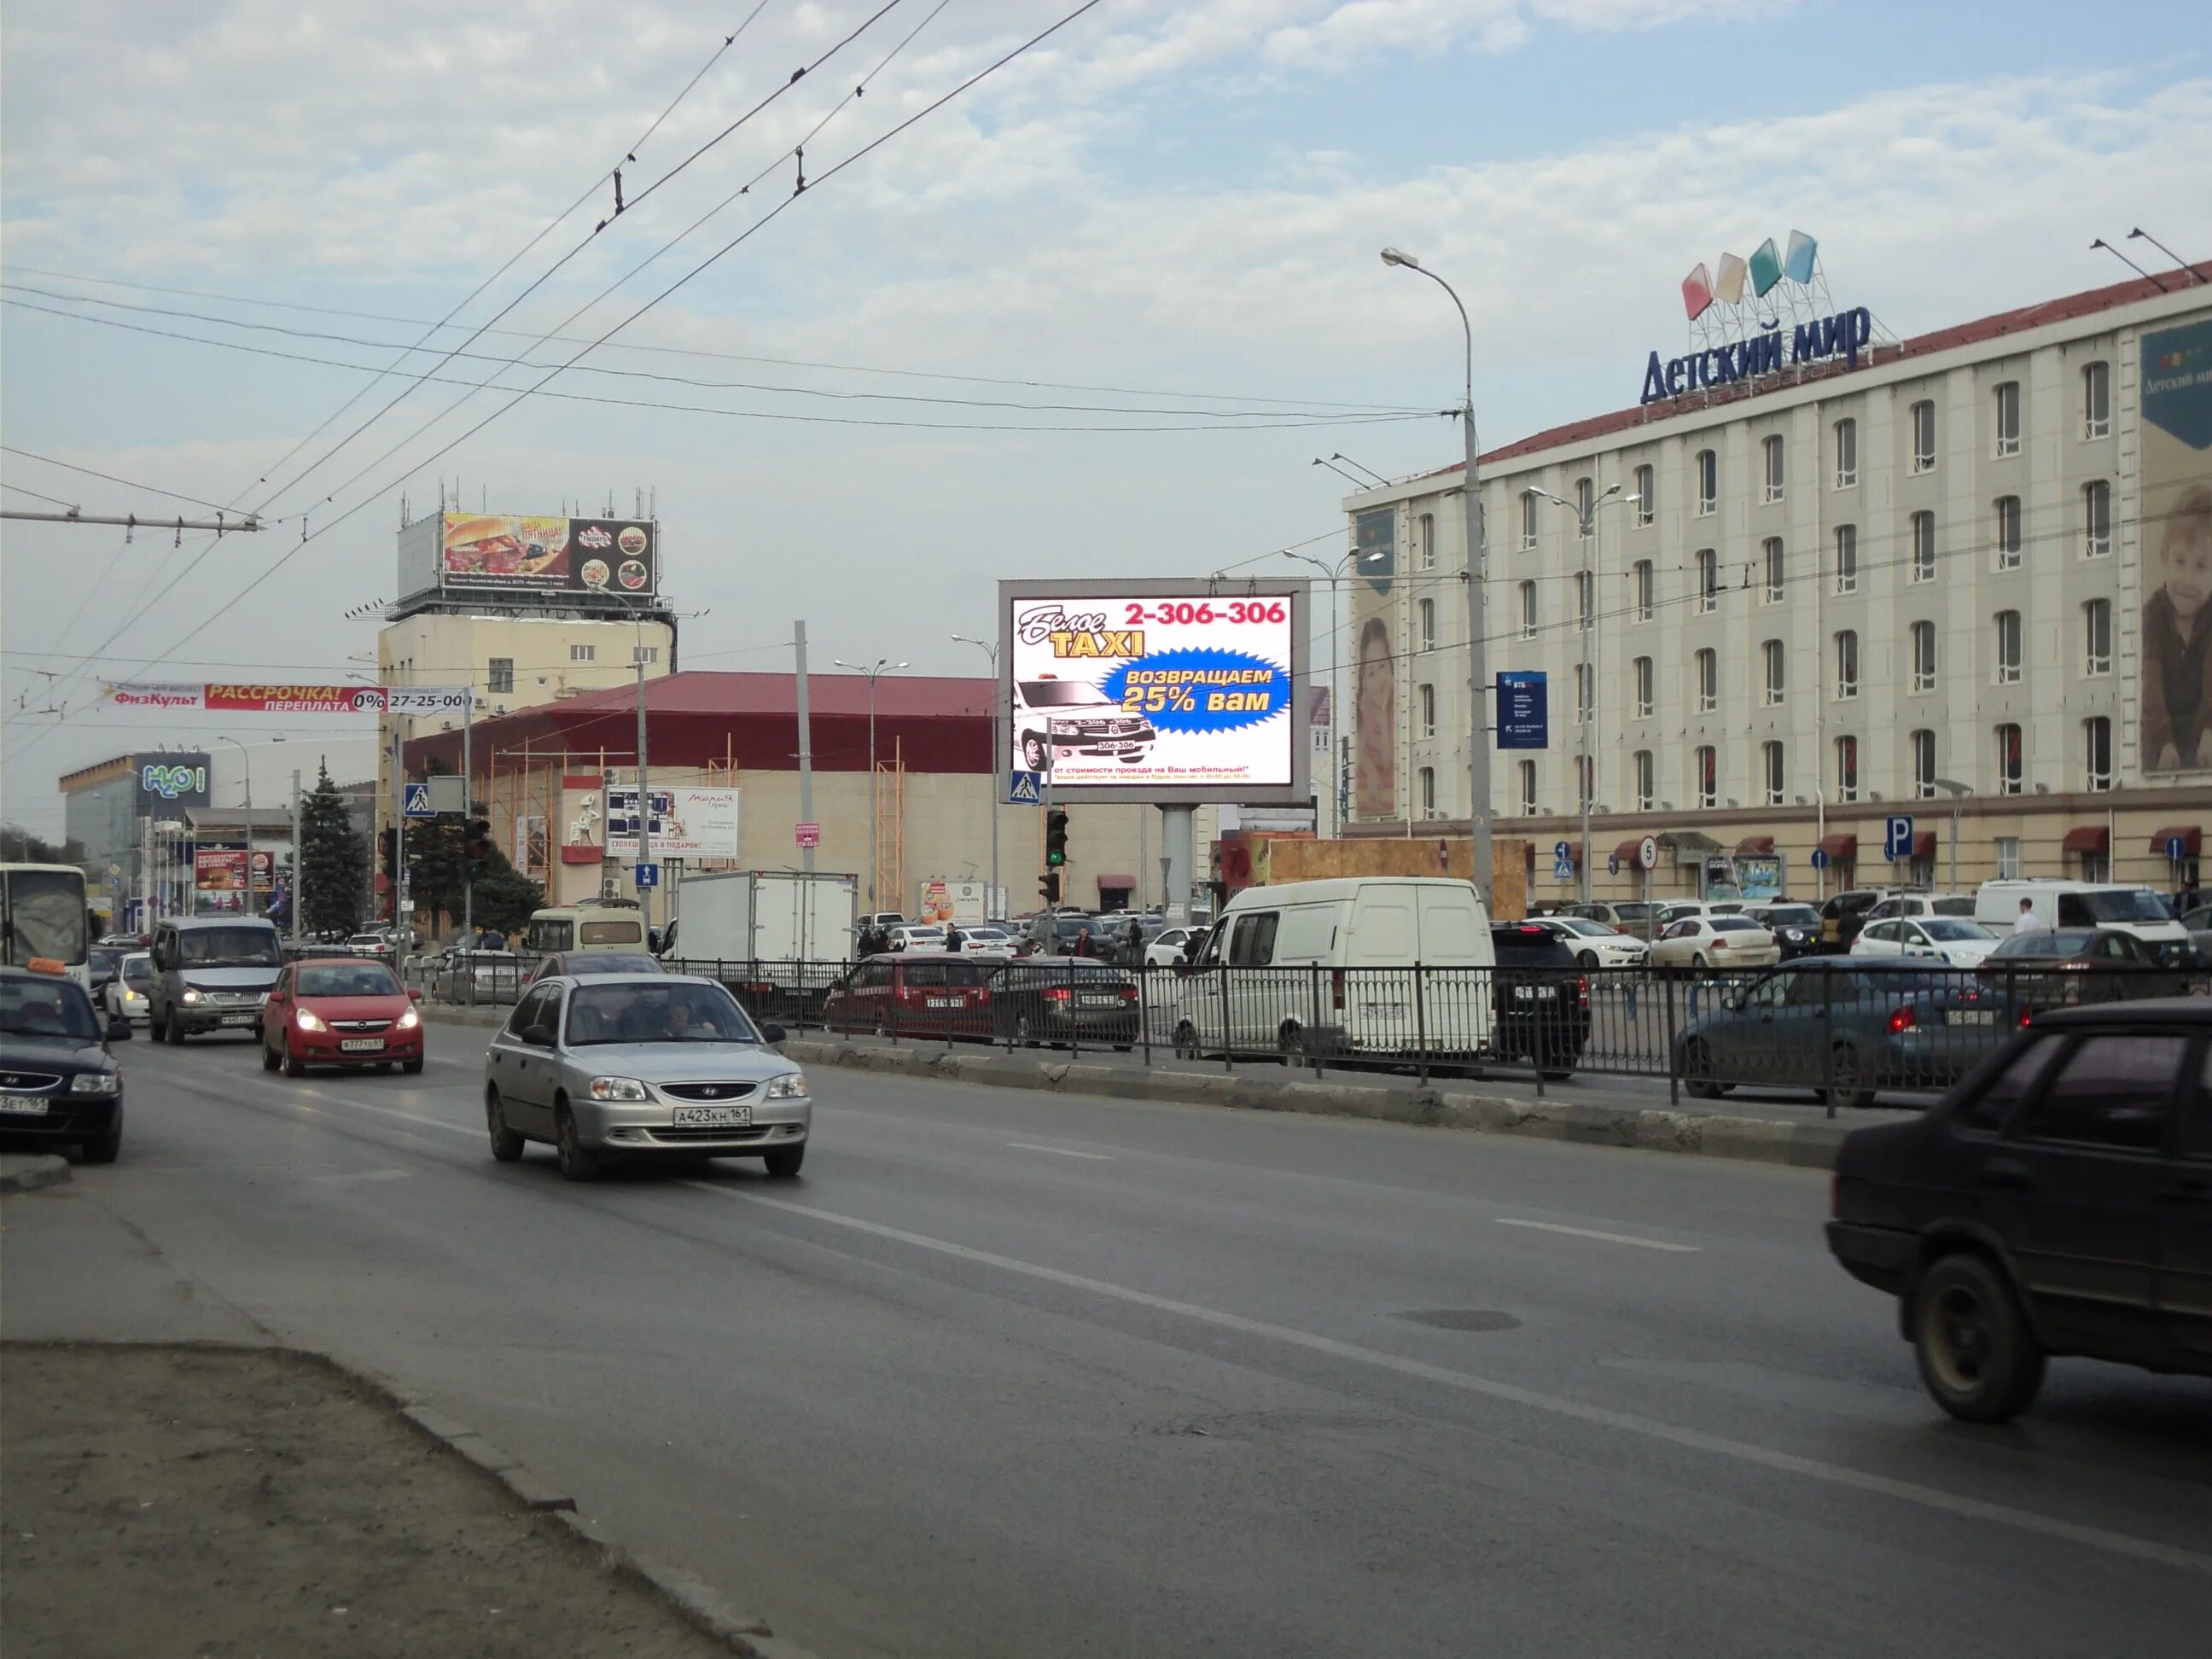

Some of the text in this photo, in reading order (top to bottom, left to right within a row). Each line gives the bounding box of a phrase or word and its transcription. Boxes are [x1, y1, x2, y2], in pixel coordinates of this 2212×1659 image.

[1639, 306, 1871, 405] Детский мир
[2144, 373, 2193, 395] Детский
[1124, 602, 1286, 625] 2-306-306
[1018, 604, 1107, 645] Белое
[1125, 669, 1273, 686] ВОЗВРАЩАЕМ
[114, 692, 199, 707] ФизКульт
[208, 685, 342, 701] РАССРОЧКА!
[353, 694, 385, 708] 0%
[1121, 686, 1271, 713] 25% вам
[265, 700, 350, 712] ПЕРЕПЛАТА
[1098, 742, 1135, 750] 306-306
[611, 841, 659, 849] СТОЛЕШЦА
[666, 841, 702, 850] ПОДАРОК!
[1646, 845, 1652, 861] 5
[678, 1109, 748, 1122] А423КН 161
